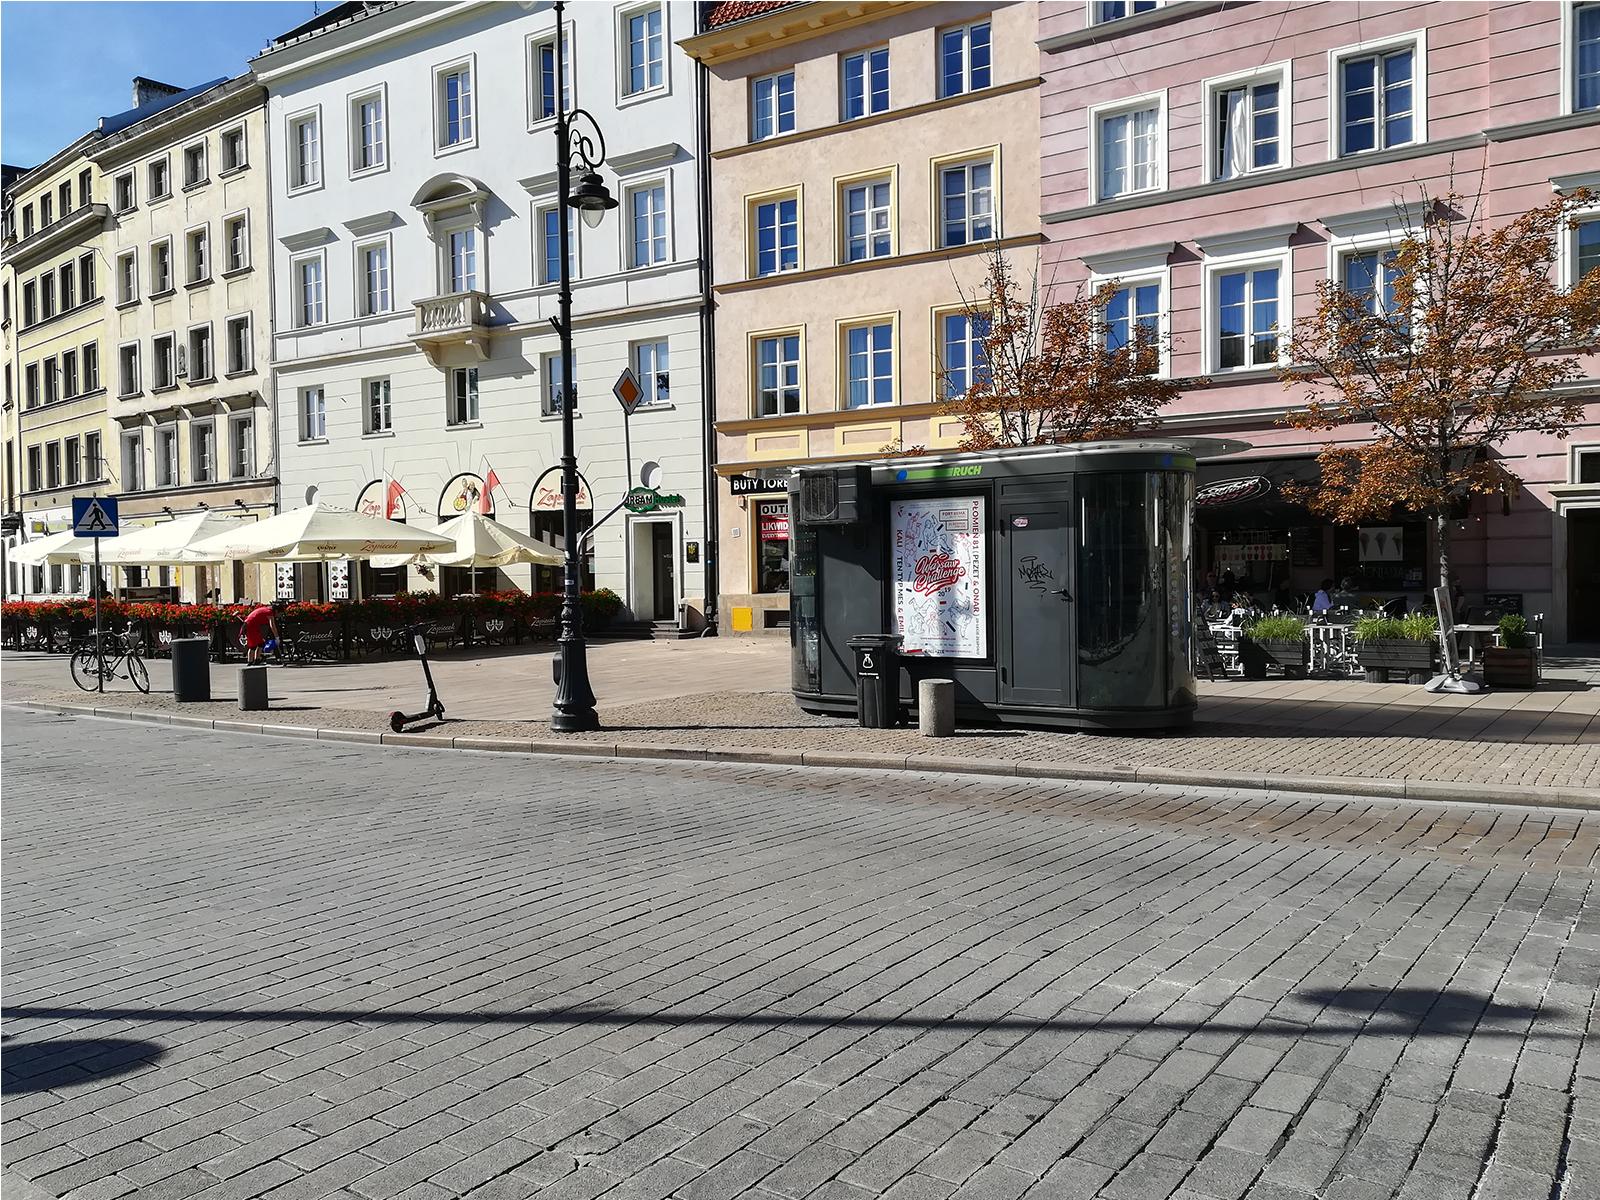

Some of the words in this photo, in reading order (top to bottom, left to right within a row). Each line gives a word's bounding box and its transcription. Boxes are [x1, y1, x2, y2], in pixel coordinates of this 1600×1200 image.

[952, 465, 982, 477] RUCH
[733, 479, 758, 491] BUTY
[914, 564, 966, 592] Challenge
